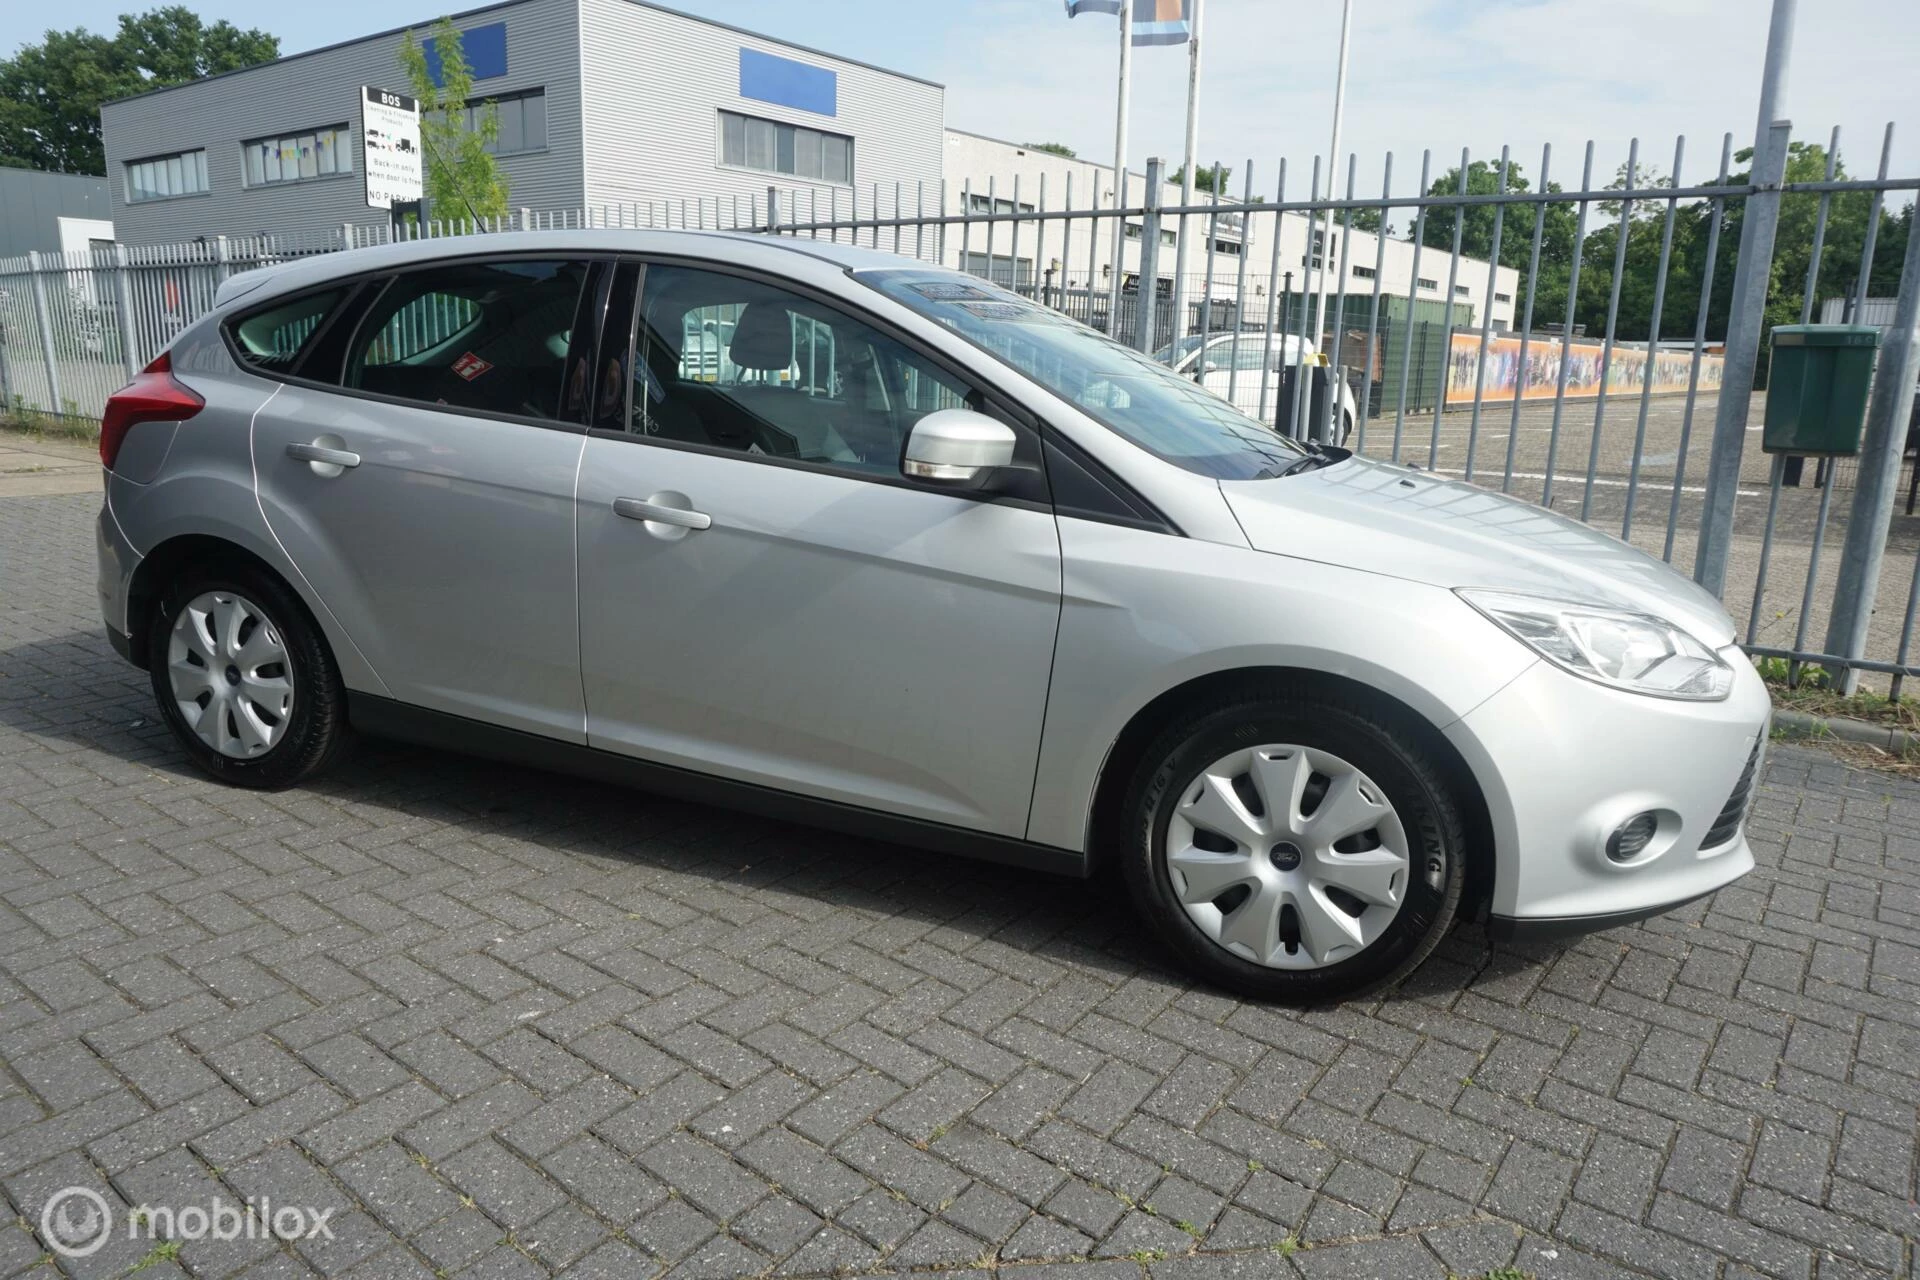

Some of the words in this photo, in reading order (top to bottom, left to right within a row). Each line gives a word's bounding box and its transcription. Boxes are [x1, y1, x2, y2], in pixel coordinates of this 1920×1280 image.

[381, 93, 400, 107] BOS
[373, 158, 400, 169] Back-in
[401, 164, 415, 174] only
[367, 170, 385, 179] when
[386, 173, 400, 182] door
[408, 177, 421, 186] free
[369, 189, 381, 201] NO
[384, 190, 416, 202] PARKIN
